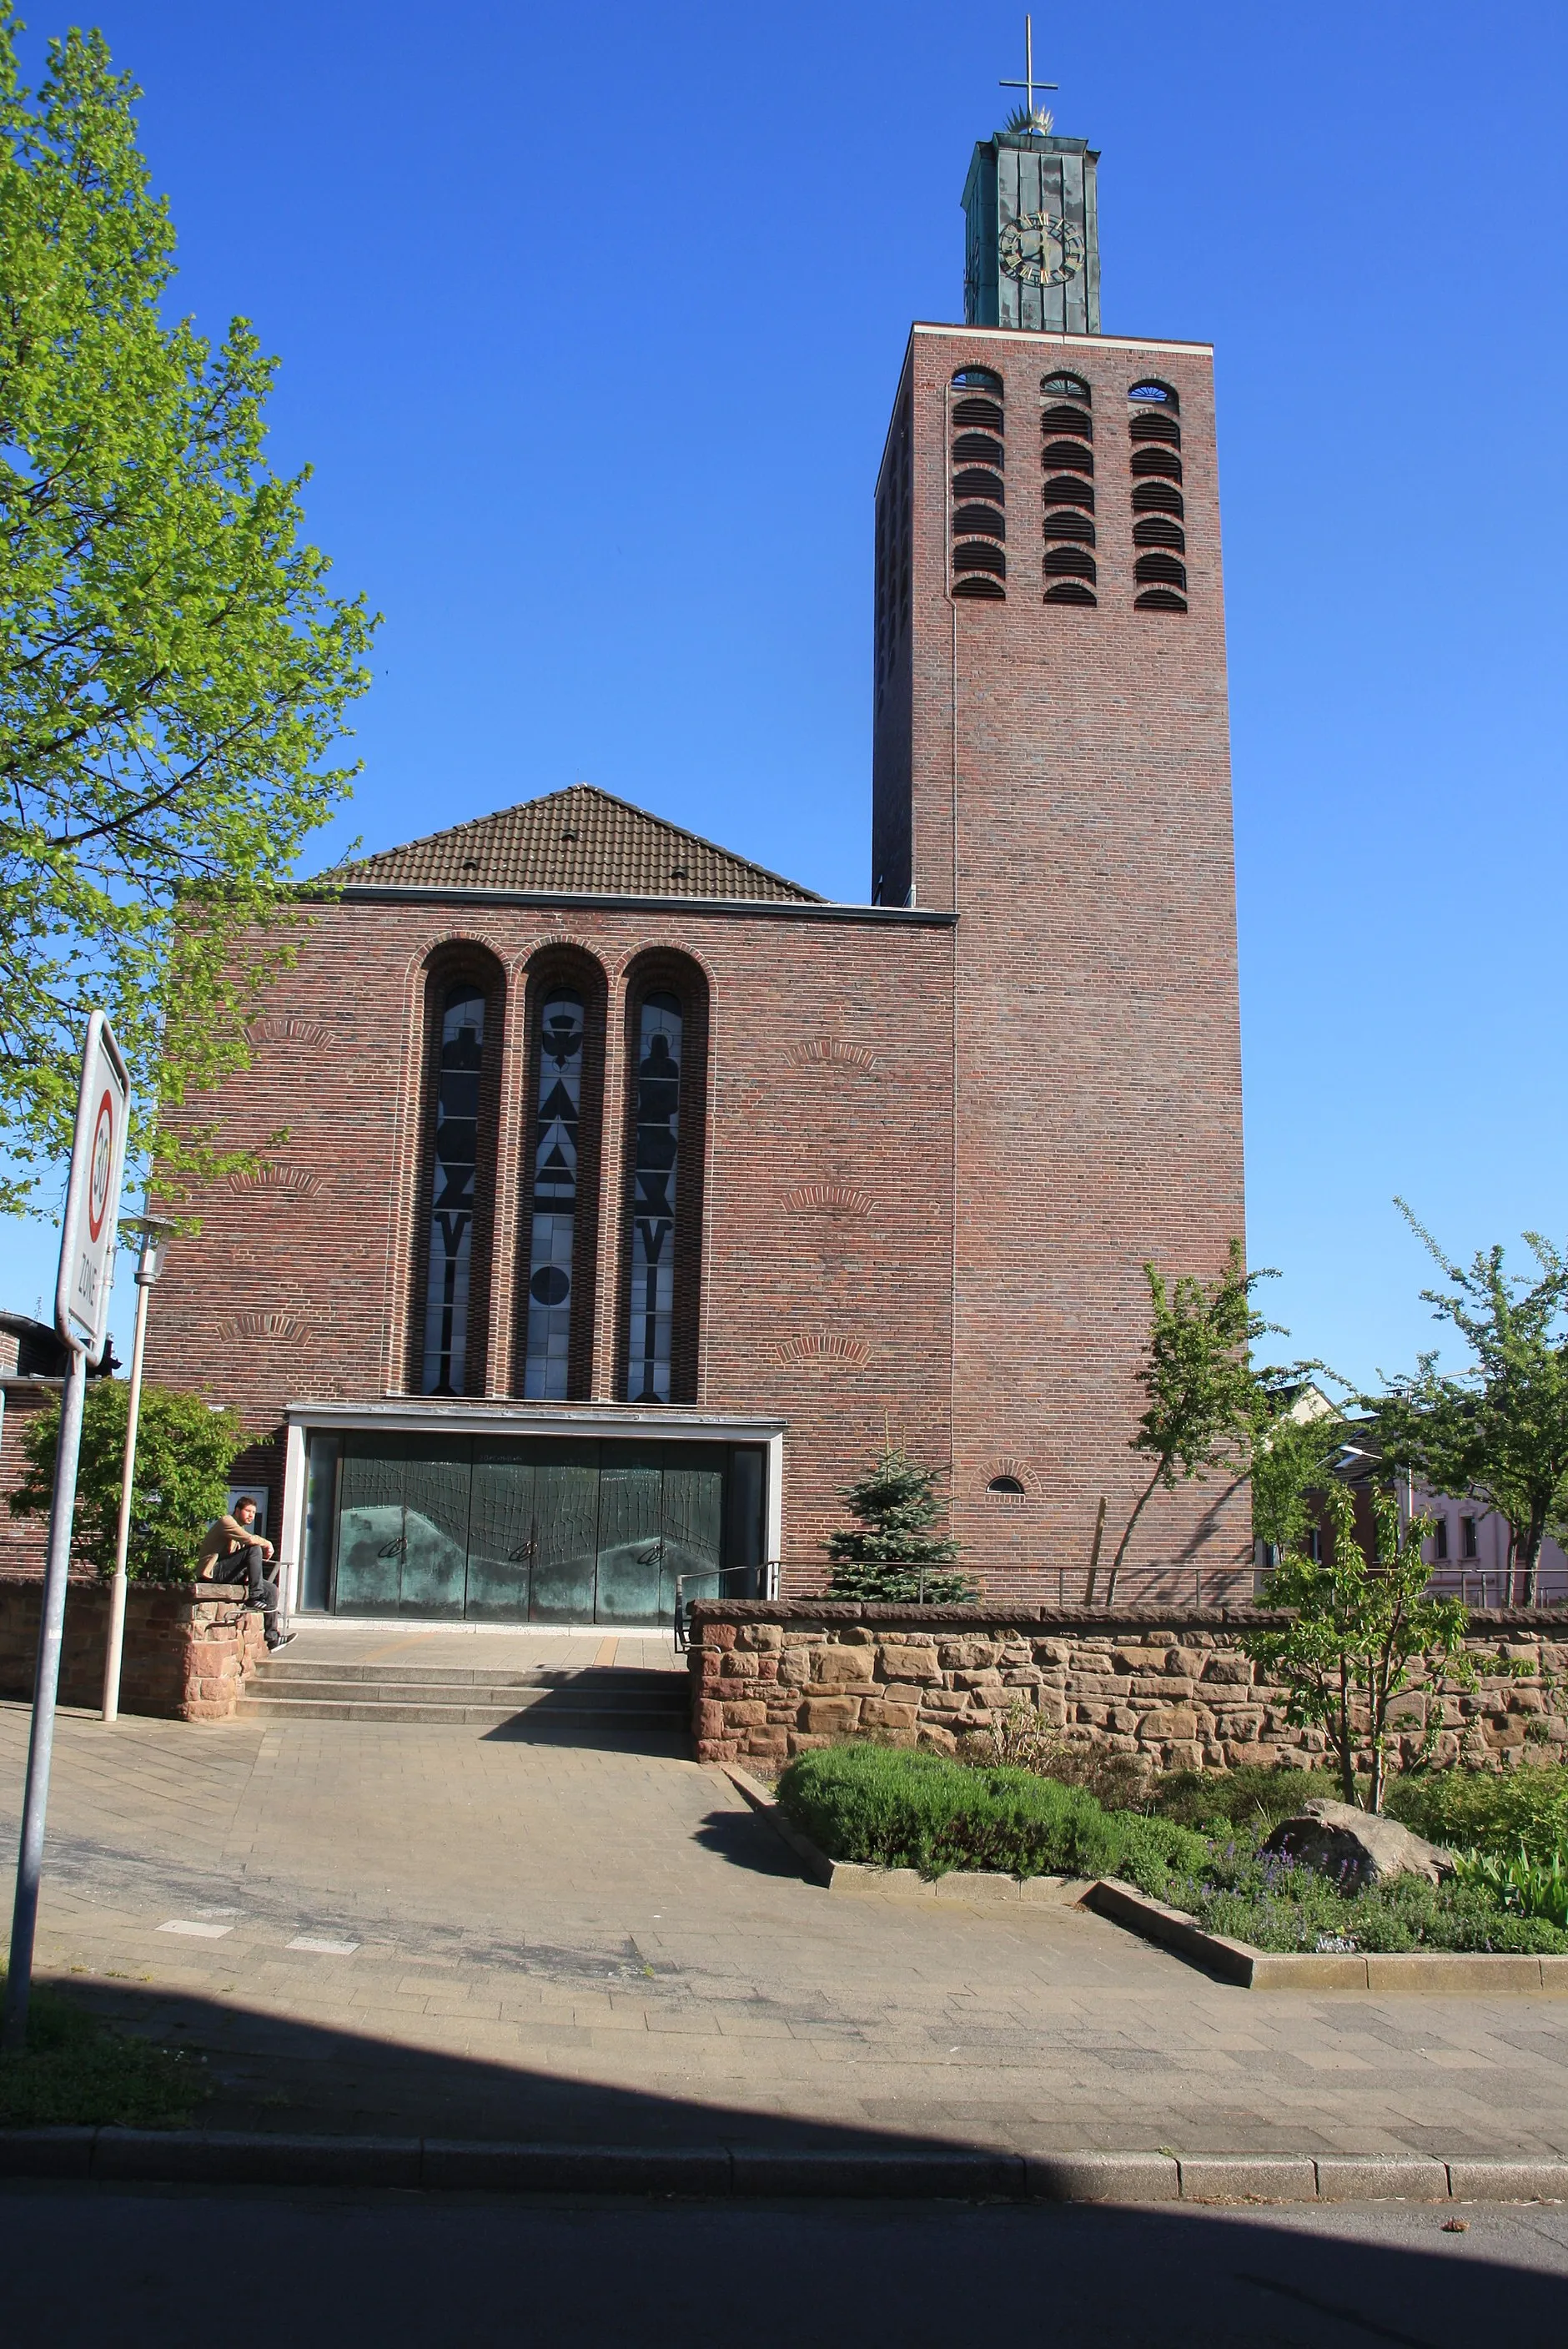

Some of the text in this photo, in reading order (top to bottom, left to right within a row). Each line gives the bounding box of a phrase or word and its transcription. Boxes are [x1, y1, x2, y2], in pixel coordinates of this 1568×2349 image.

[1037, 212, 1049, 226] XII
[93, 1127, 109, 1203] 30
[78, 1252, 98, 1306] ZONE
